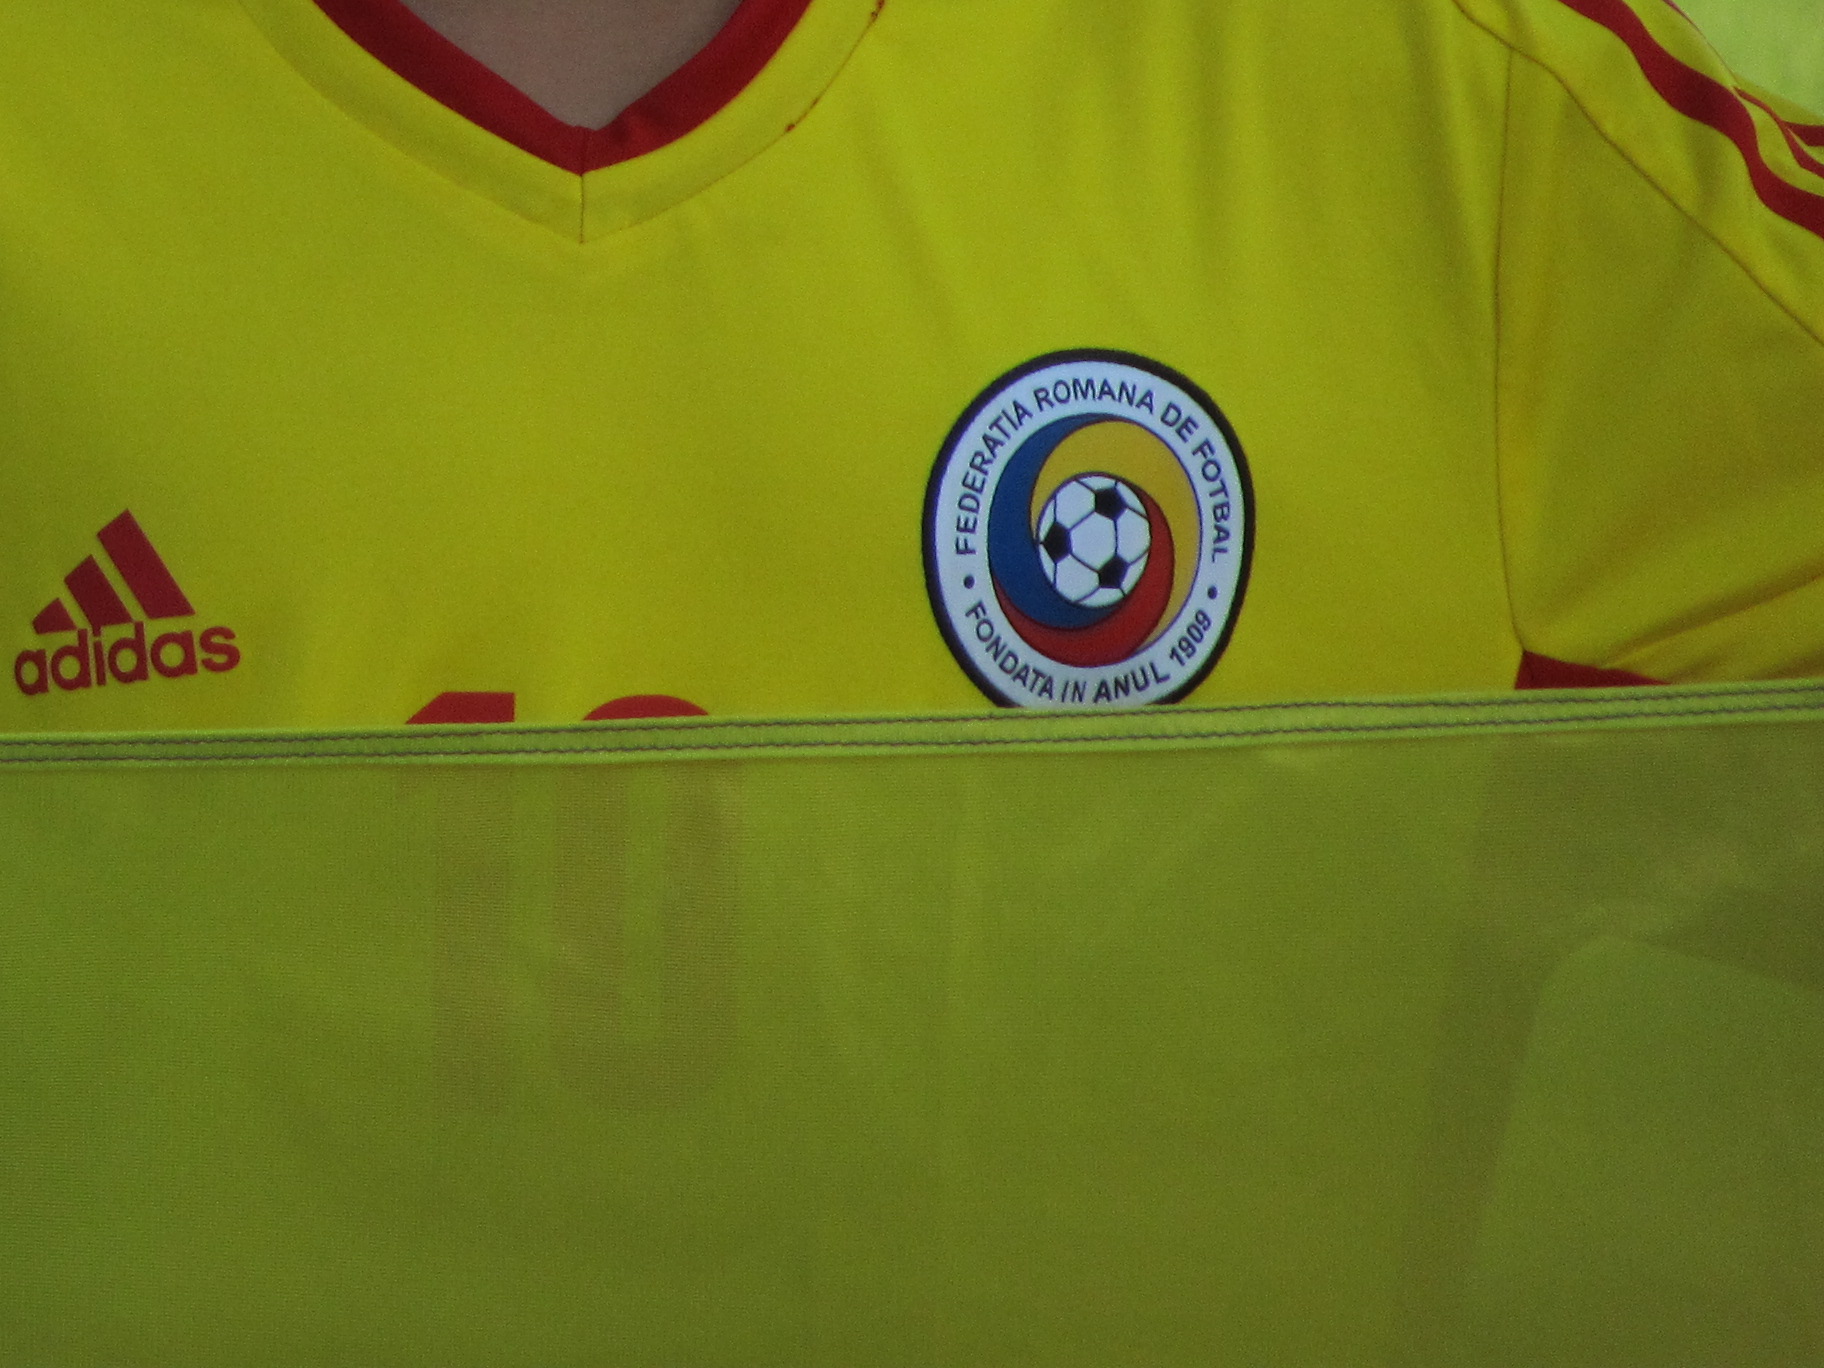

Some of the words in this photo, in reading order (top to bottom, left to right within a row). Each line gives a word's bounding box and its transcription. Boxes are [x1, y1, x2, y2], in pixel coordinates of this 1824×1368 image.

[955, 401, 1033, 554] FEDERATIA
[1034, 378, 1156, 415] ROMANA
[1161, 402, 1199, 443] DE
[1192, 439, 1231, 563] FOTBAL
[14, 620, 241, 696] adidas
[966, 600, 1054, 702] FONDATA
[1061, 681, 1086, 703] IN
[1093, 661, 1171, 704] ANUL
[1168, 610, 1213, 667] 1909
